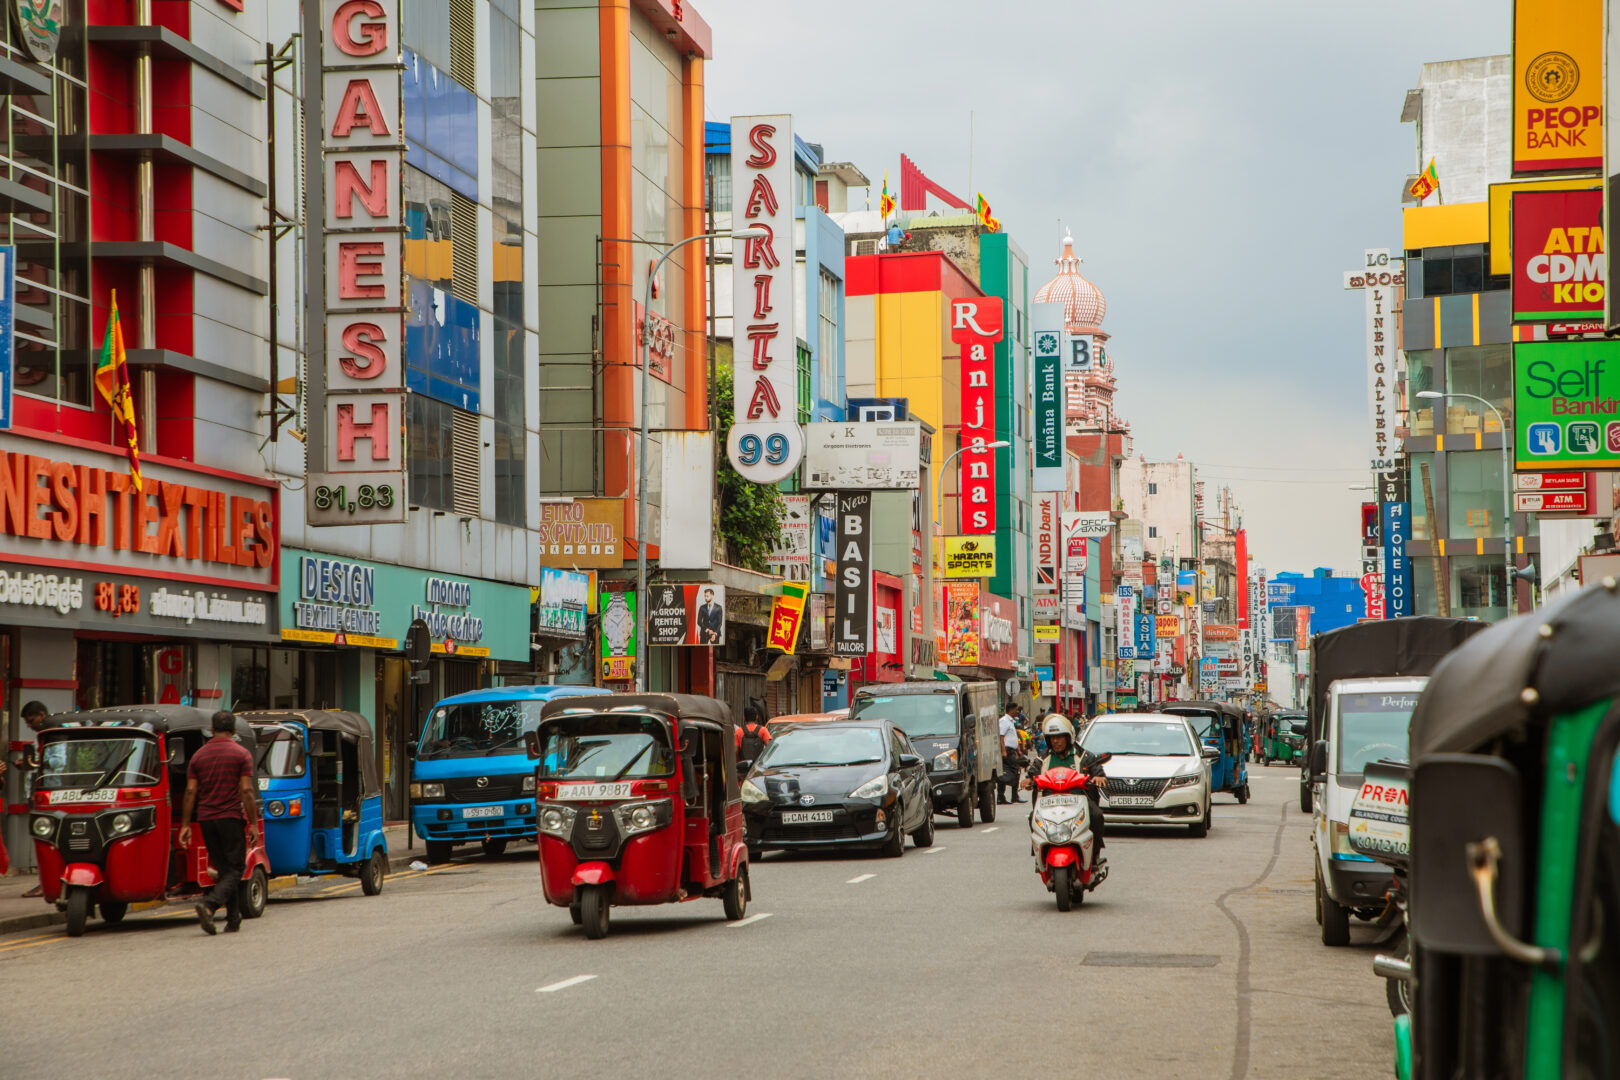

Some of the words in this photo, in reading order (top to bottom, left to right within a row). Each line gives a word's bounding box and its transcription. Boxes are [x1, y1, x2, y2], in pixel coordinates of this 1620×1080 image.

[1527, 105, 1602, 129] PEOP
[1527, 129, 1587, 149] BANK
[331, 0, 390, 462] GANESH
[746, 123, 780, 420] SARITA
[1367, 253, 1389, 267] LG
[1374, 290, 1384, 356] LINEN
[1042, 363, 1054, 402] Bank
[1526, 360, 1606, 399] Self
[952, 302, 1000, 530] Ranjanas
[1374, 362, 1387, 457] GALLERY
[845, 427, 855, 438] K
[738, 433, 790, 465] 99
[1371, 459, 1393, 470] 104
[314, 484, 394, 514] 81,83
[841, 495, 868, 513] New
[1553, 495, 1573, 504] ATM
[106, 471, 274, 568] TEXTILES
[540, 501, 584, 523] ETRO
[1040, 499, 1051, 530] bank
[953, 552, 993, 561] HAZANA
[1040, 534, 1050, 564] NDB
[1392, 522, 1402, 569] FONE
[947, 560, 993, 569] SPORTS
[302, 557, 375, 607] DESIGN
[842, 516, 862, 640] BASIL
[96, 582, 140, 617] 81,83
[1036, 598, 1057, 607] ATM
[295, 602, 342, 629] TEXTILE
[342, 608, 380, 634] CENTRE
[654, 618, 683, 626] RENTAL
[659, 608, 685, 616] GROOM
[658, 628, 679, 636] SHOP
[1140, 616, 1150, 650] ASHA
[837, 641, 865, 653] TAILORS
[1120, 648, 1133, 657] 153
[611, 667, 629, 677] WATCH
[613, 660, 625, 668] CITY
[570, 786, 595, 797] AAV
[600, 784, 629, 796] 9887
[791, 813, 808, 822] CAH
[811, 812, 832, 821] 4118
